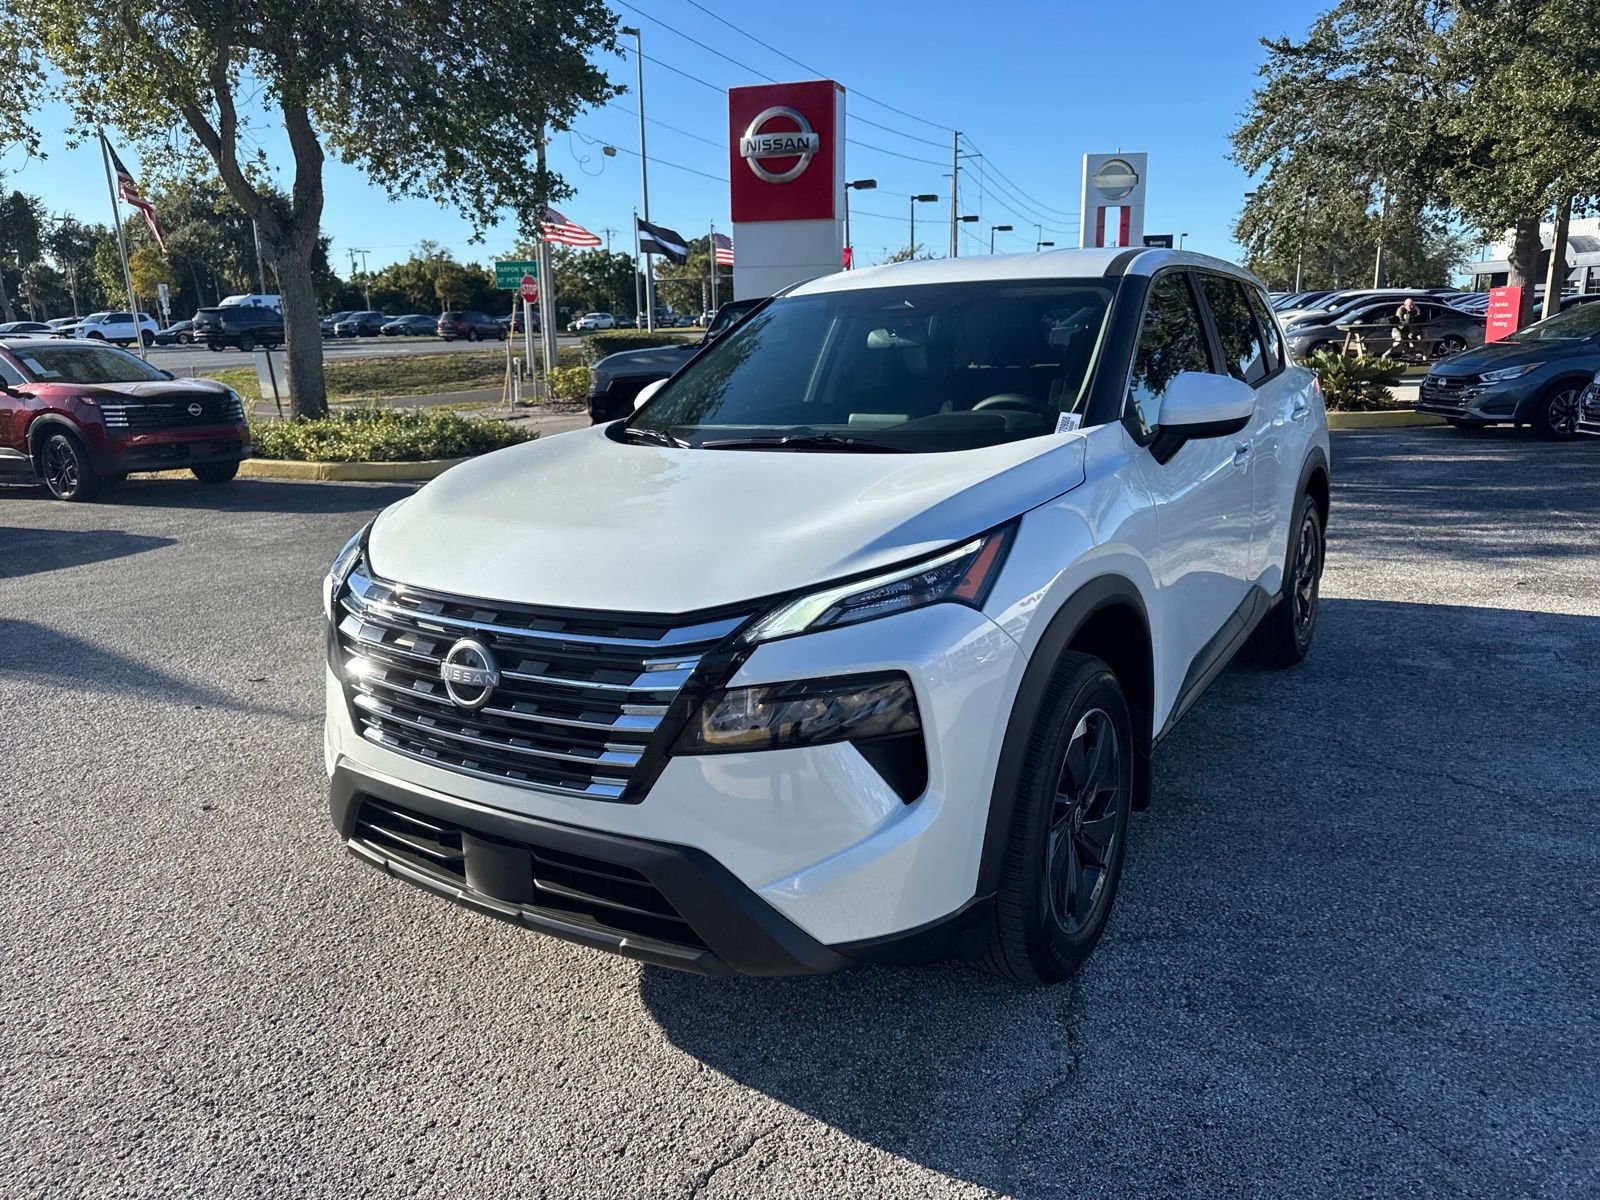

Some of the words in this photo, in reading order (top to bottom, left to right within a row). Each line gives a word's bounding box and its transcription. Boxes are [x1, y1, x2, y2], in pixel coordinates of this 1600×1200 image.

[746, 137, 810, 152] NISSAN
[522, 284, 537, 295] STOP
[441, 664, 497, 685] NISSAN
